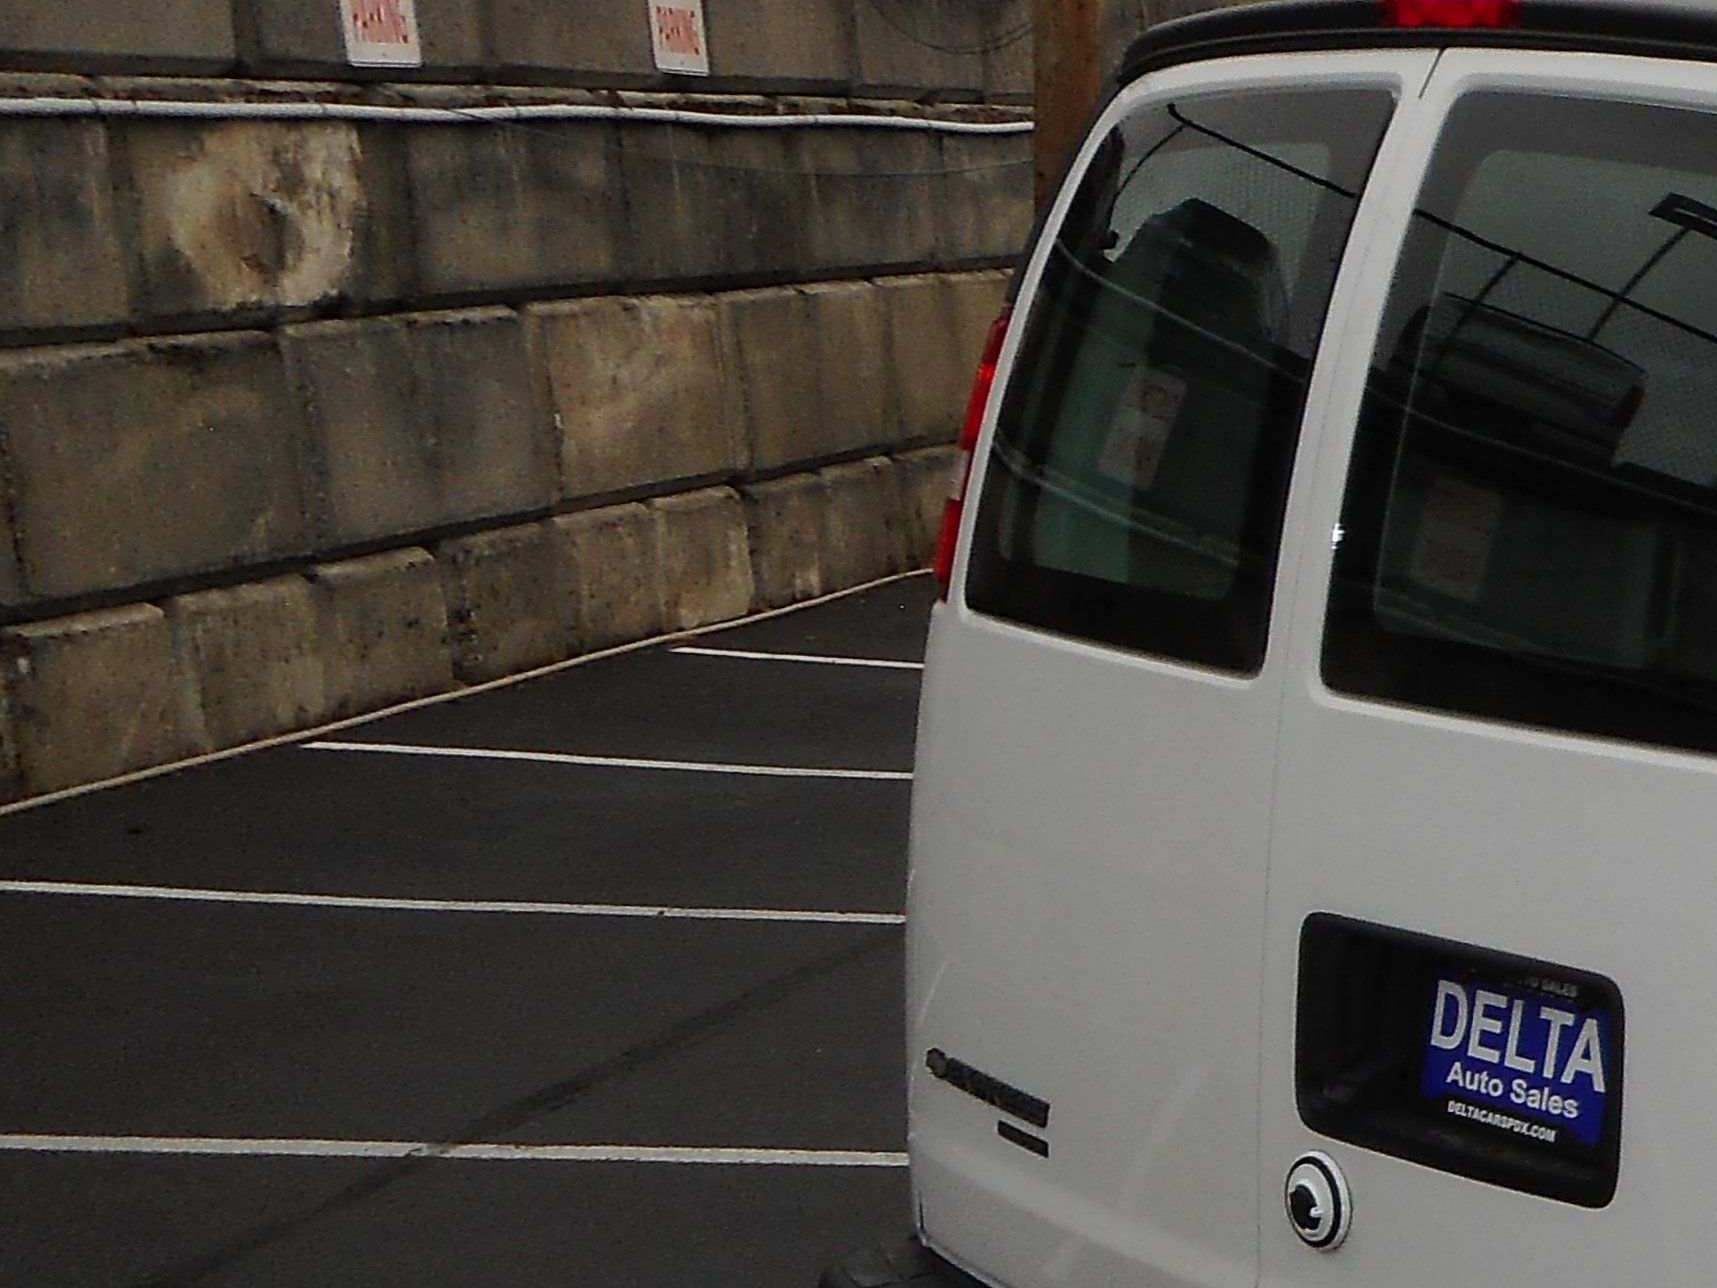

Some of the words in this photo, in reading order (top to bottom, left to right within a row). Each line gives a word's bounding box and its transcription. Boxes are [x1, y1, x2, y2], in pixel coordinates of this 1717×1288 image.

[1430, 979, 1606, 1093] DELTA
[1446, 1061, 1504, 1098] Auto
[1509, 1078, 1580, 1119] Sales
